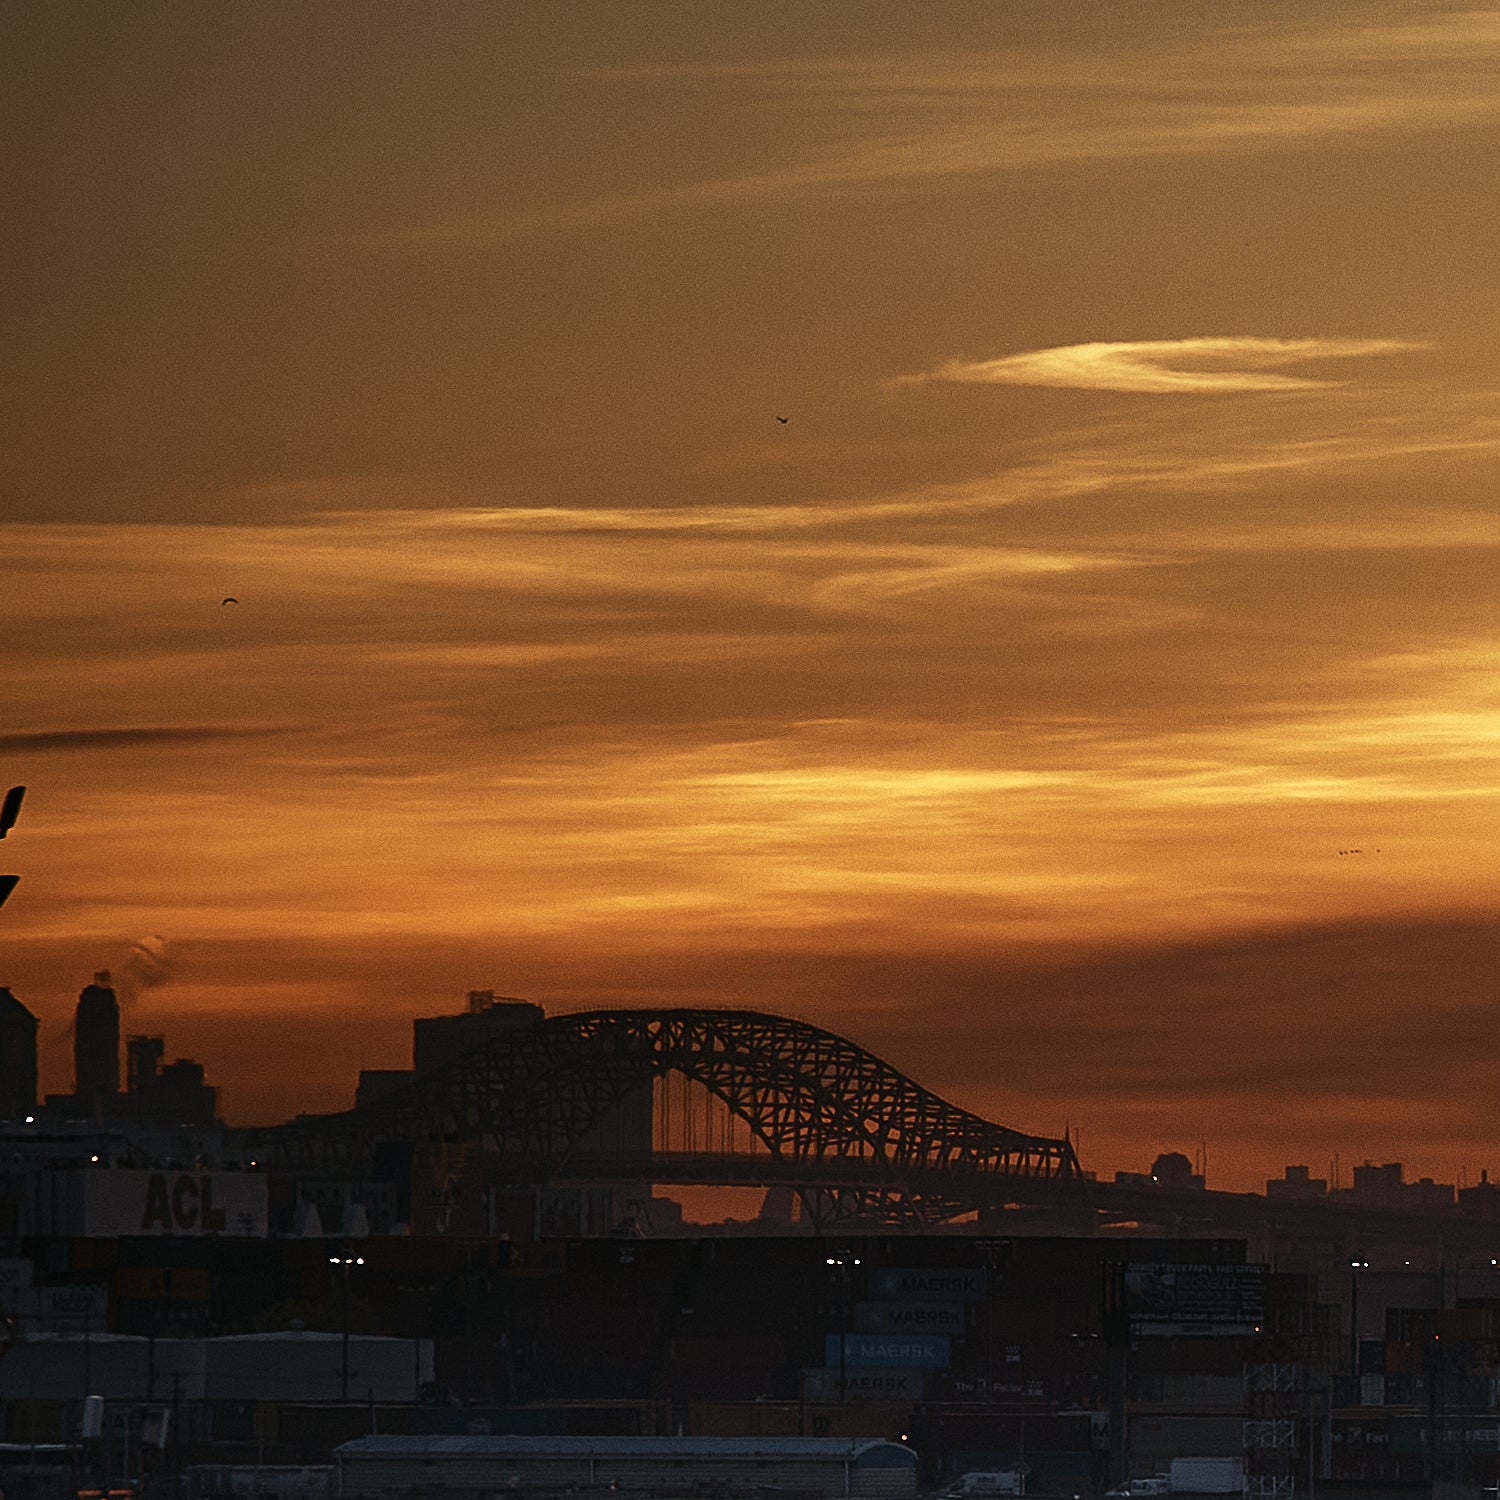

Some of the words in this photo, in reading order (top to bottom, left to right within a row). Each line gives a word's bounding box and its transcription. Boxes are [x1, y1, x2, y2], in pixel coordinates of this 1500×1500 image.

[142, 1174, 227, 1232] ACL
[902, 1278, 975, 1291] MAERSK
[888, 1311, 961, 1325] MAERSK
[860, 1345, 935, 1358] MAERSK
